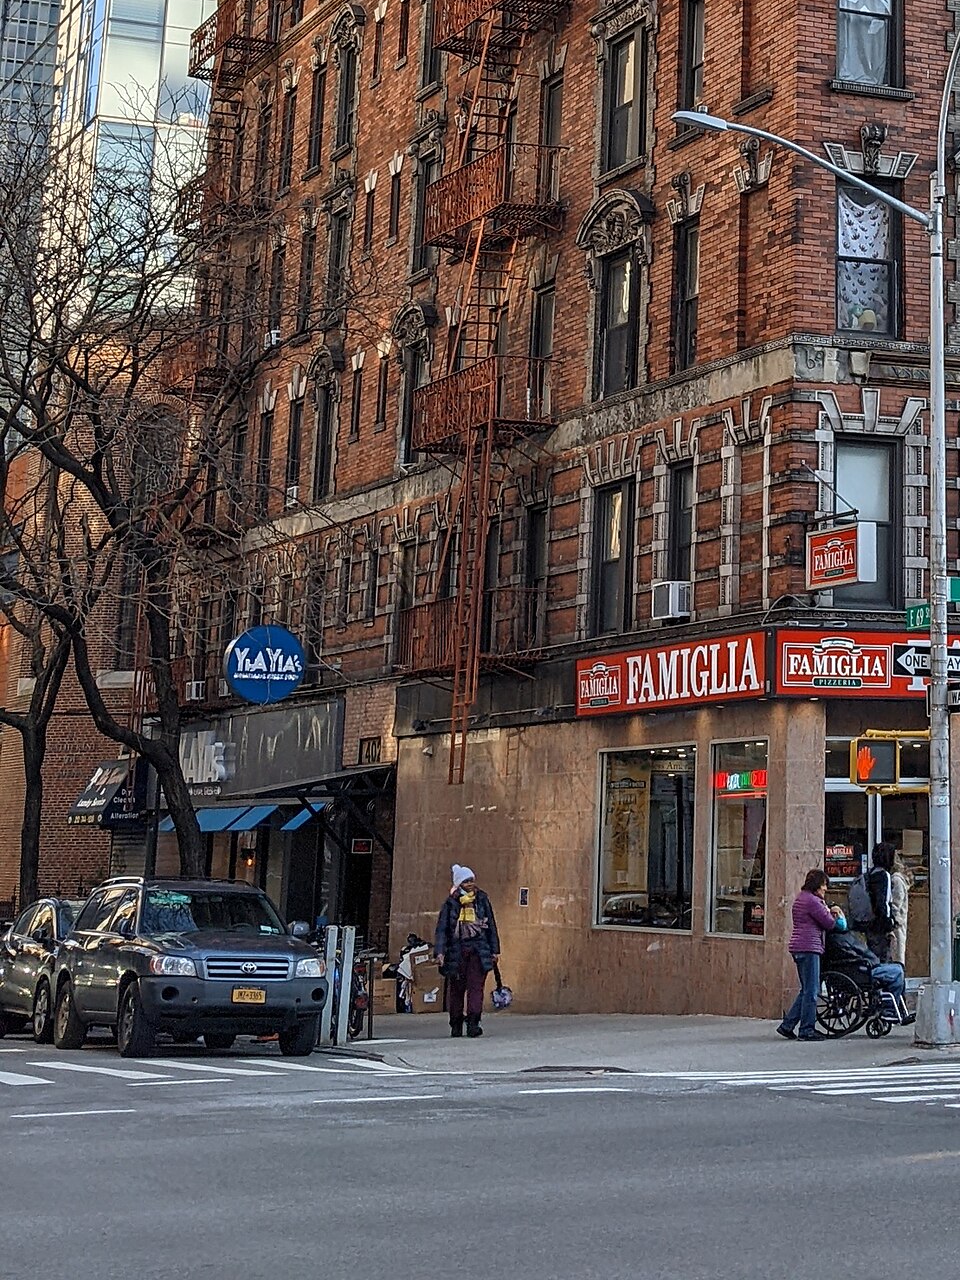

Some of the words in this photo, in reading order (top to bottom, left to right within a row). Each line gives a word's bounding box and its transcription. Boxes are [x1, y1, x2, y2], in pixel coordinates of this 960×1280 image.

[814, 548, 854, 571] FAMIGLIA
[910, 609, 914, 627] E
[915, 607, 924, 626] 69
[626, 637, 760, 705] FAMIGLIA
[788, 653, 884, 678] FAMIGLIA
[905, 654, 928, 668] ONE
[580, 674, 618, 699] FAMIGLIA
[819, 679, 858, 688] PIZZERIA
[826, 847, 853, 856] FAMIGLIA
